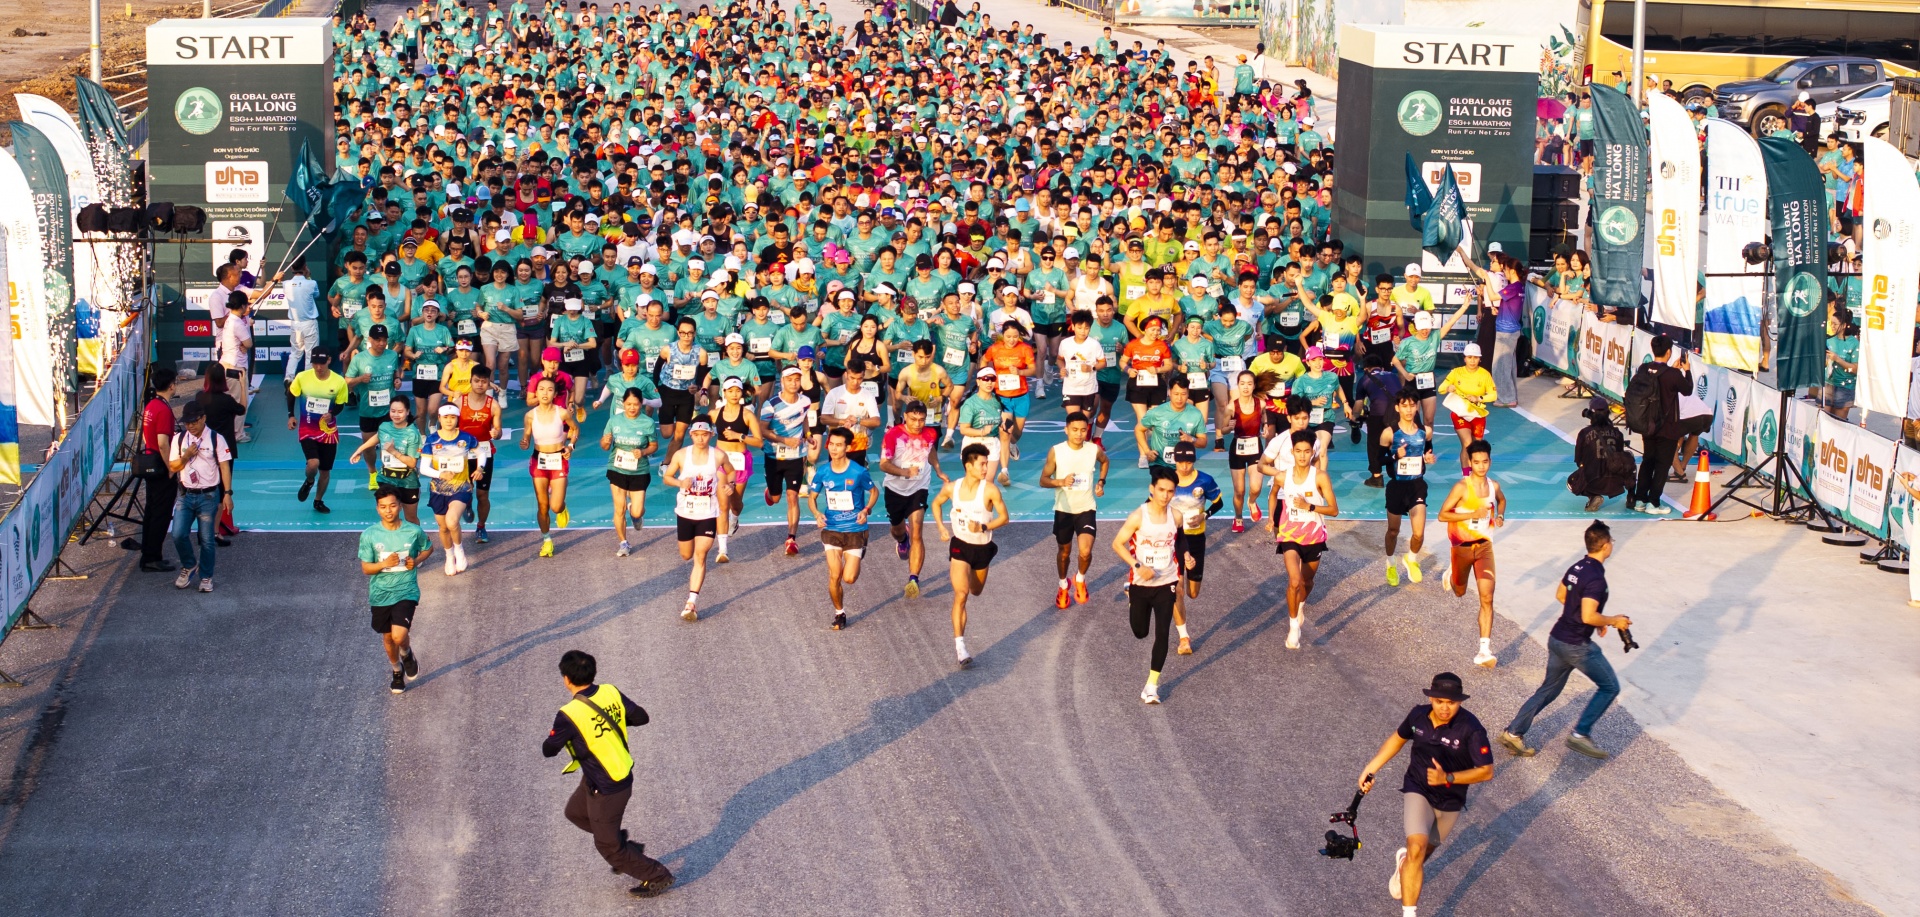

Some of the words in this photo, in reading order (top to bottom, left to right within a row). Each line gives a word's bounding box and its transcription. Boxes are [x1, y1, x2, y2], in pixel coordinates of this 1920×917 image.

[176, 36, 294, 60] START
[1403, 41, 1514, 66] START
[230, 102, 252, 112] HA
[256, 102, 296, 112] LONG
[1450, 106, 1470, 116] HA
[1472, 106, 1512, 118] LONG
[1488, 98, 1512, 106] GATE
[1613, 144, 1622, 181] LONG
[216, 166, 258, 186] dha
[1716, 176, 1740, 191] TH
[1612, 183, 1622, 200] HA
[1714, 192, 1759, 214] true
[1657, 208, 1676, 256] dha
[1790, 200, 1801, 244] LONG
[1796, 247, 1802, 265] HA
[1865, 274, 1888, 330] dha
[1586, 327, 1602, 355] dha
[1607, 337, 1624, 366] dha
[1821, 438, 1848, 474] dha
[1856, 454, 1883, 491] dha
